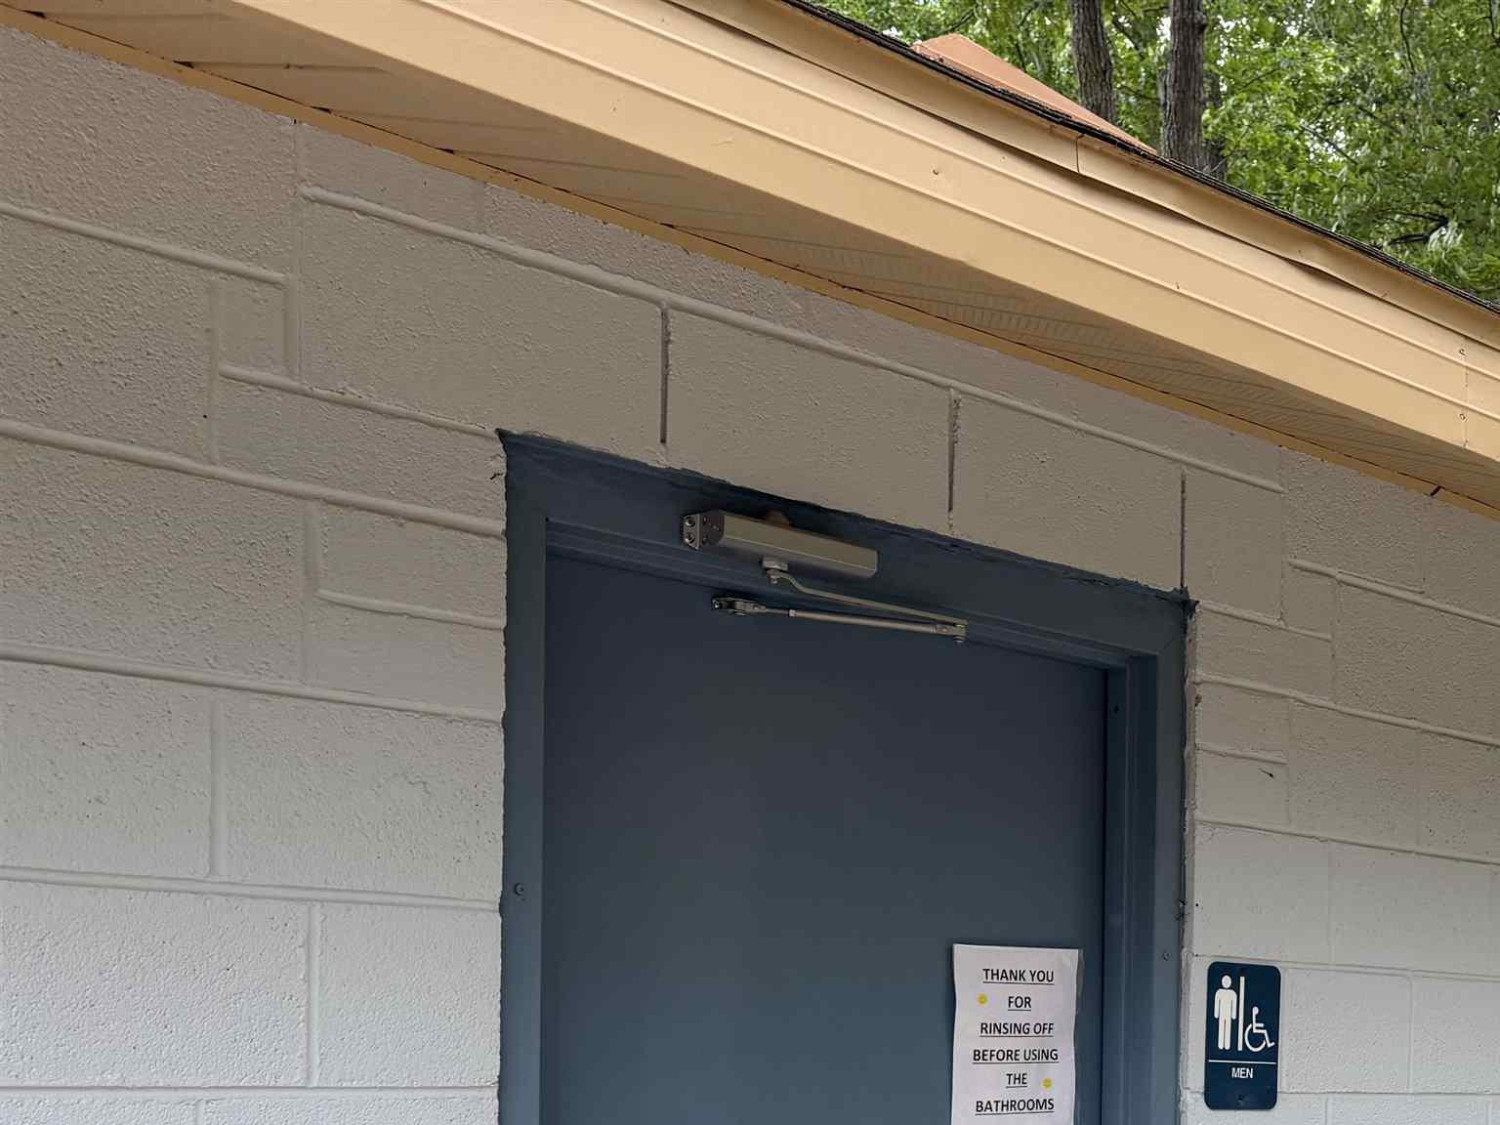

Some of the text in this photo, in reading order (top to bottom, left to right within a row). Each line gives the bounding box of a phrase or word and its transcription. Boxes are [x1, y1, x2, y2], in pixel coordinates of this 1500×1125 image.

[983, 969, 1054, 983] THANK YOU
[1007, 996, 1032, 1009] FOR
[980, 1022, 1054, 1035] RINSING OFF
[973, 1048, 1059, 1062] BEFORE USING
[1006, 1073, 1028, 1085] THE
[1231, 1067, 1253, 1079] MEN
[976, 1098, 1055, 1112] BATHROOMS
